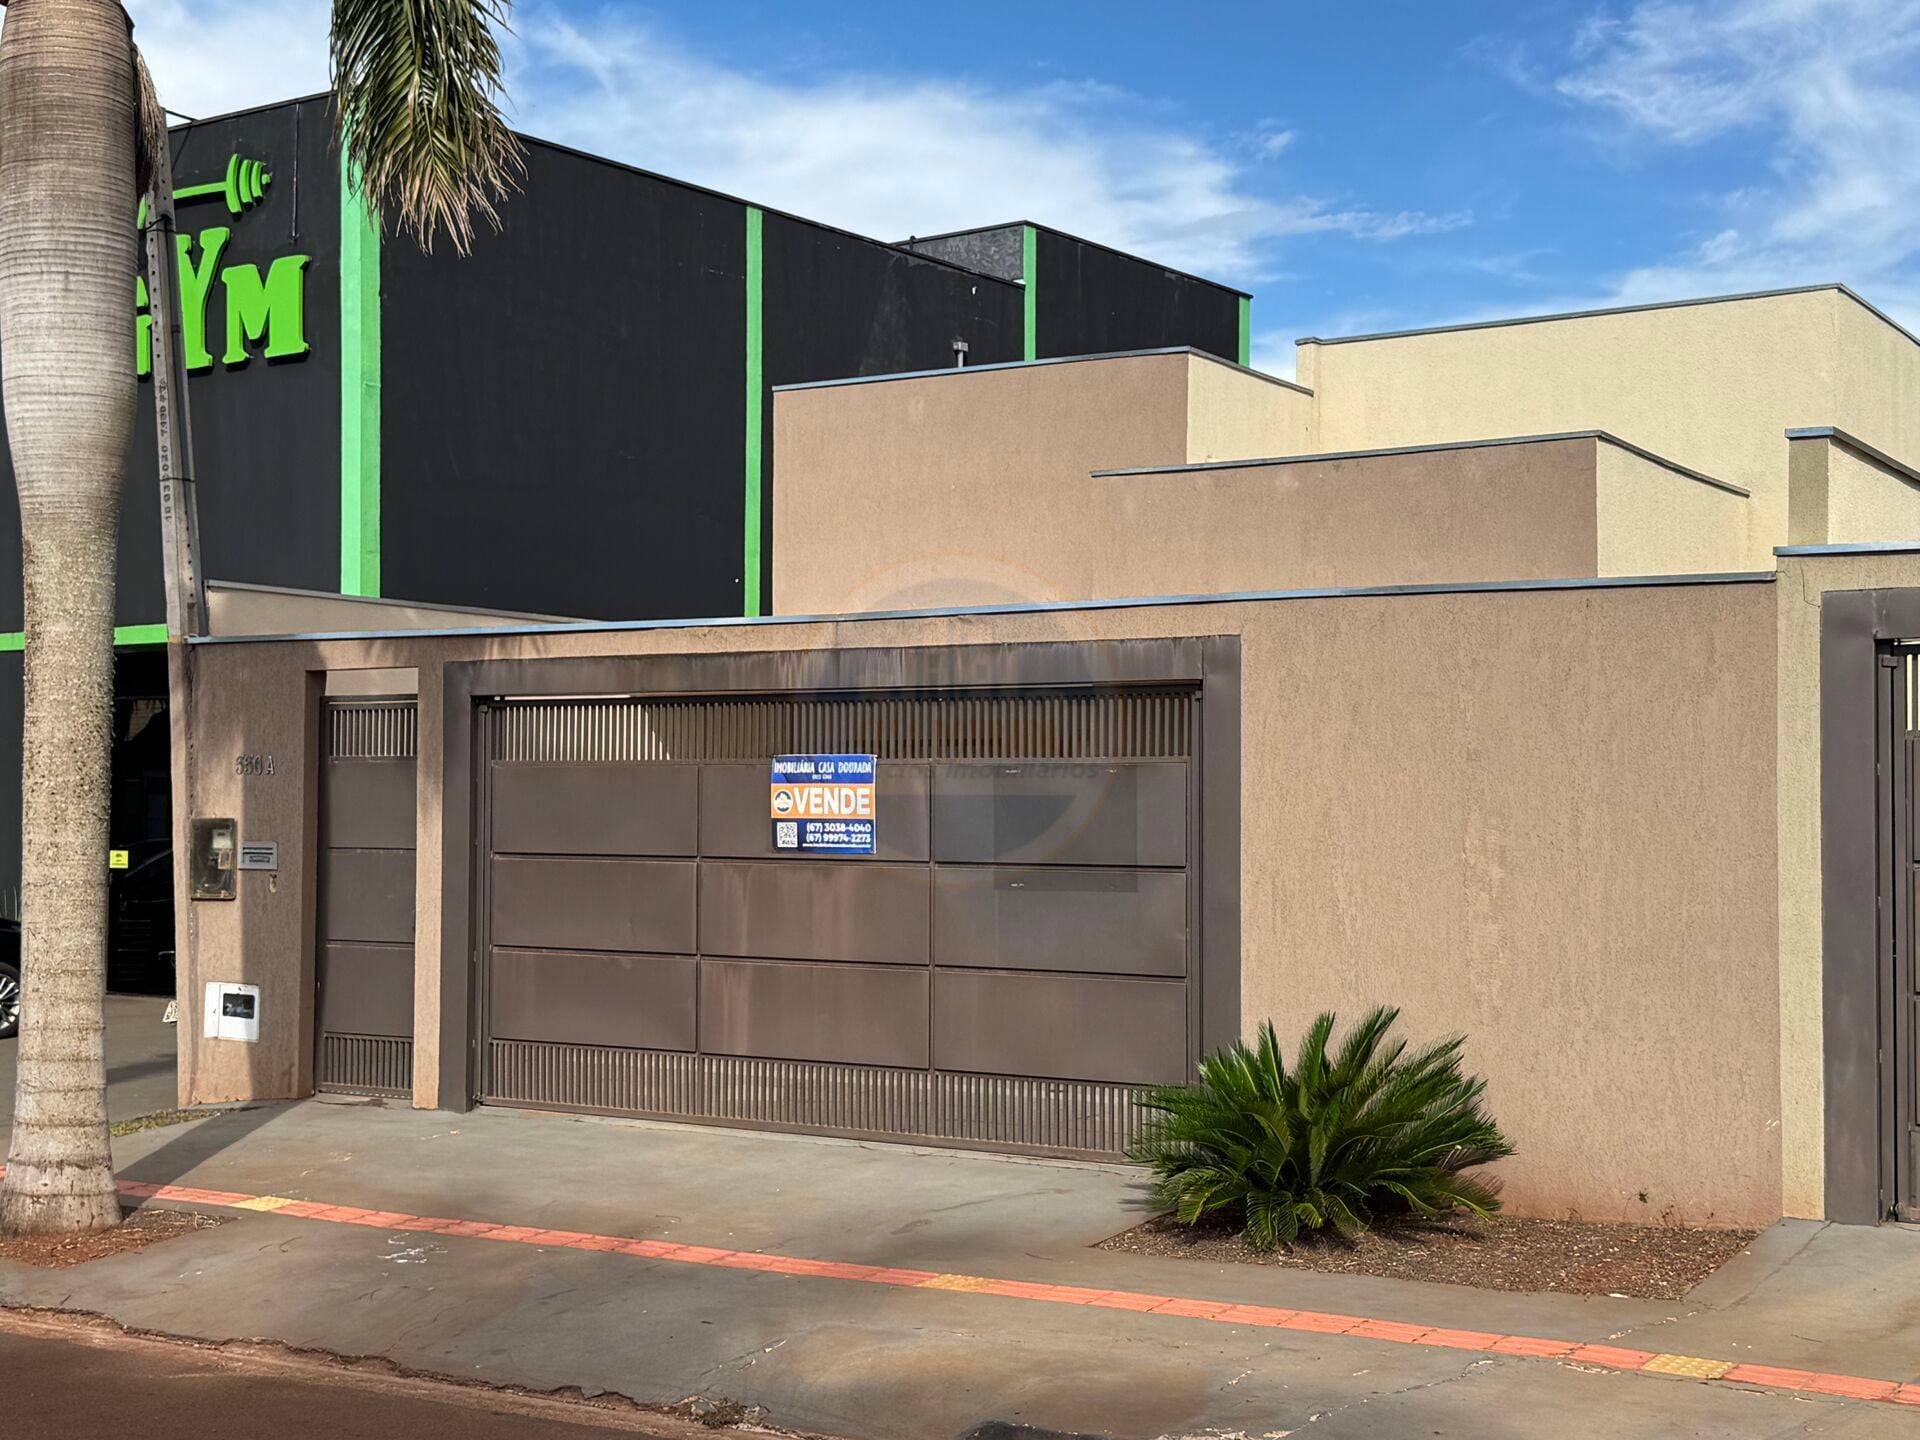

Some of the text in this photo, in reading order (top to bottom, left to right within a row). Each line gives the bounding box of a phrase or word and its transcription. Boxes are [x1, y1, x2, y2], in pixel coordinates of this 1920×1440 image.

[818, 761, 835, 773] CASA
[838, 761, 872, 773] DOURADA
[793, 787, 870, 815] VENDE
[806, 822, 872, 832] (67) 3038-4040
[806, 833, 822, 843] (67)
